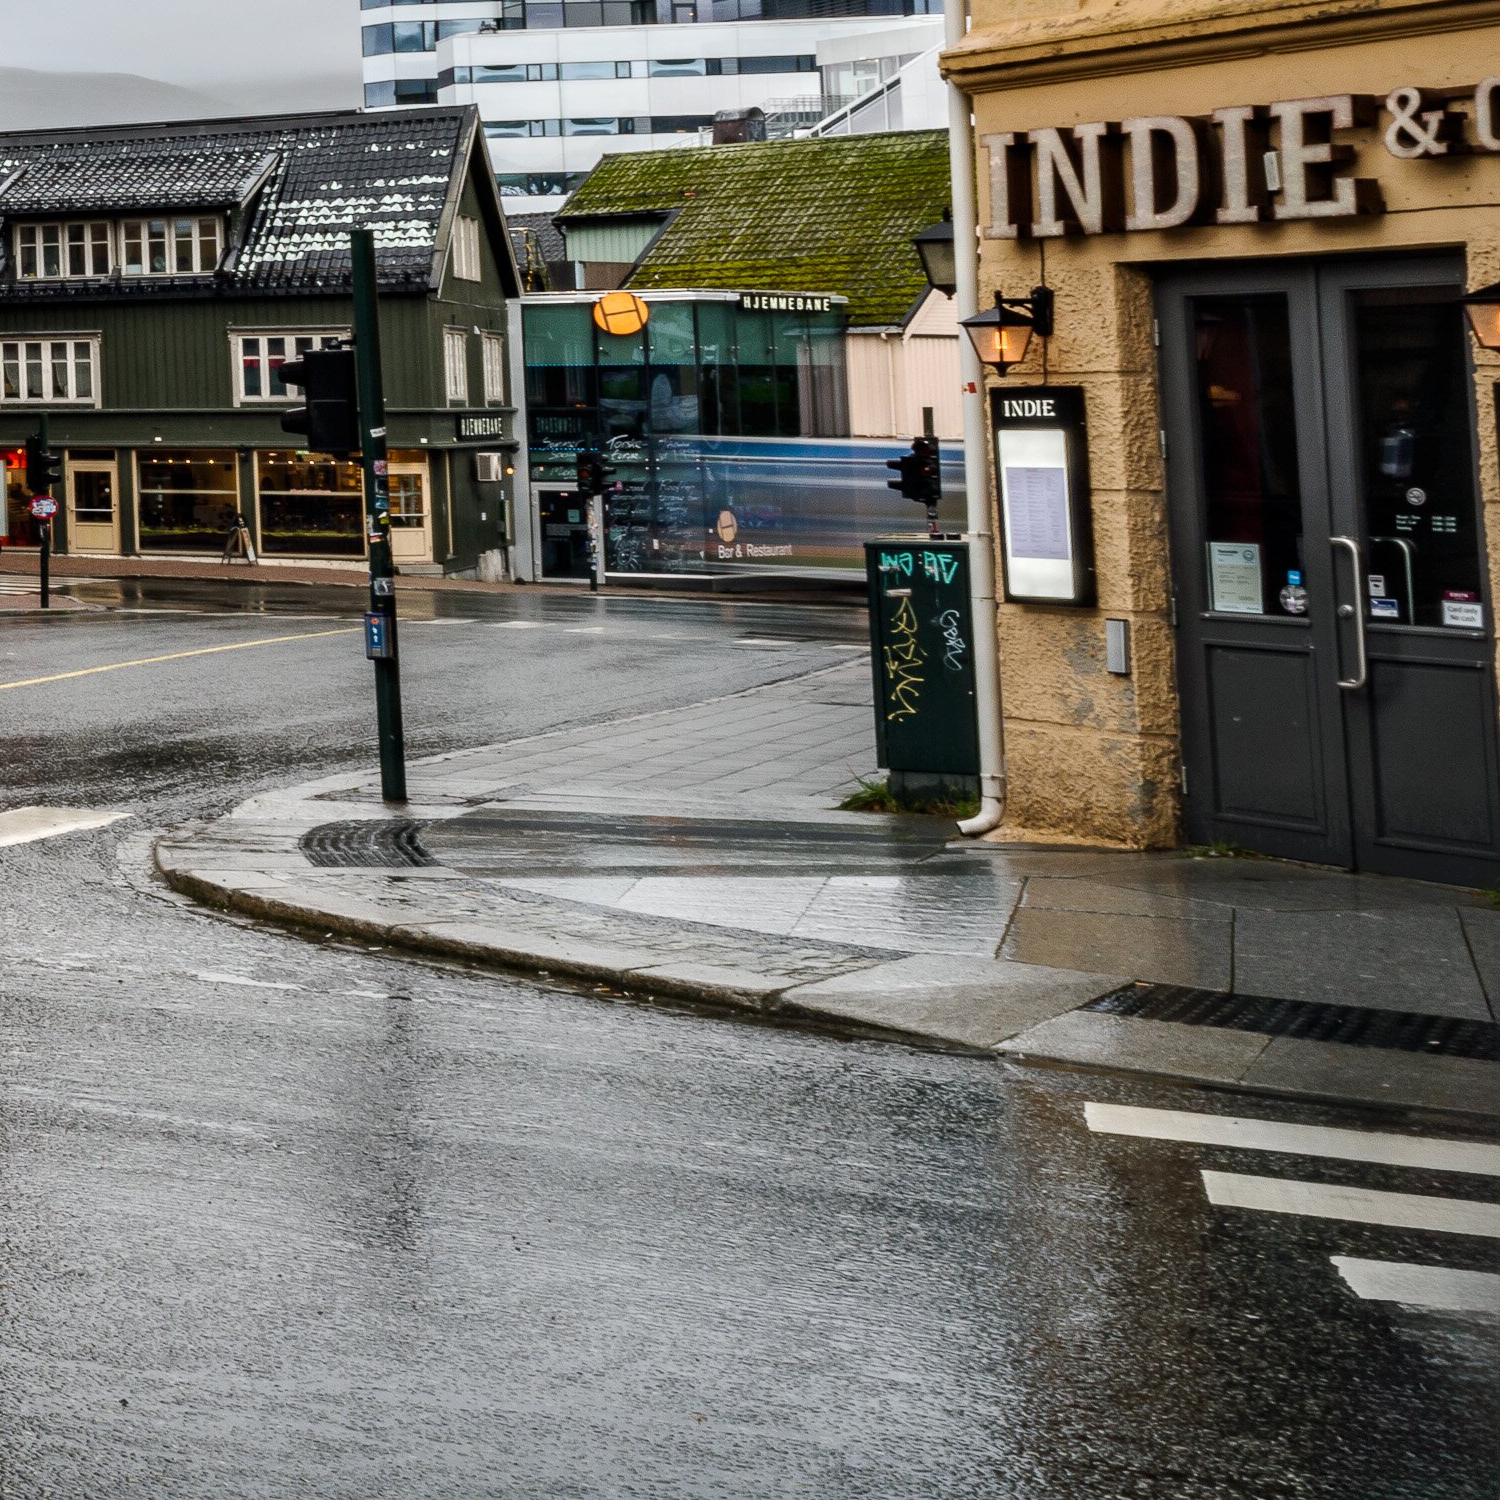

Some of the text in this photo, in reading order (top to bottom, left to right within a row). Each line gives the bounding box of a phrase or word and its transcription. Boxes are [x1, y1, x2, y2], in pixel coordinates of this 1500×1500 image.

[979, 93, 1360, 241] INDIE
[1384, 86, 1448, 159] &
[742, 296, 831, 312] HJEMMEBANE
[1003, 399, 1056, 418] INDIE
[718, 543, 793, 559] Bar & Restaurant
